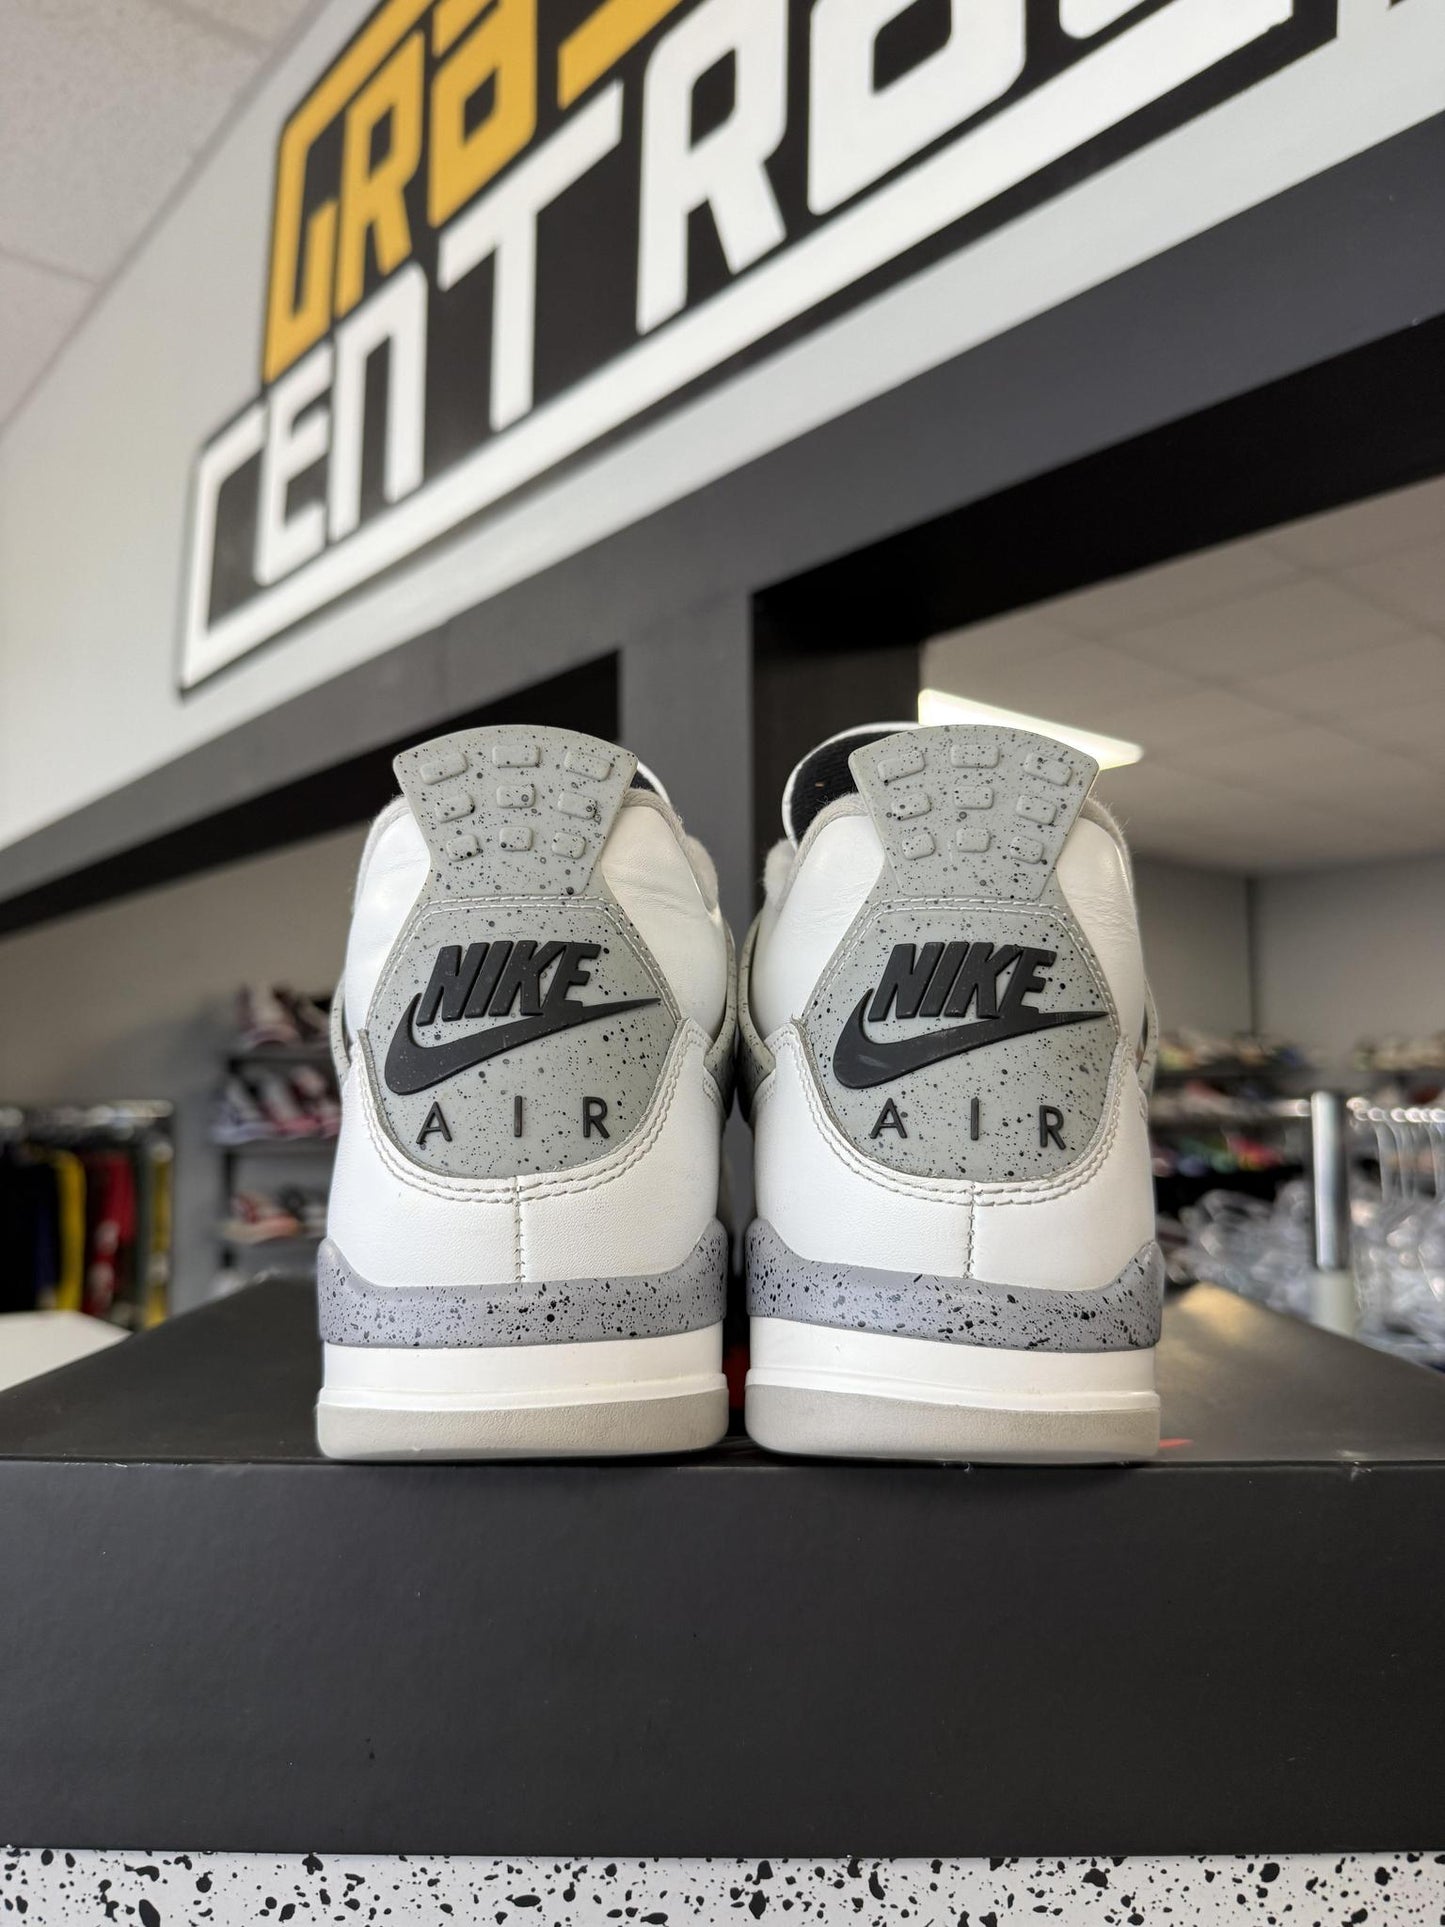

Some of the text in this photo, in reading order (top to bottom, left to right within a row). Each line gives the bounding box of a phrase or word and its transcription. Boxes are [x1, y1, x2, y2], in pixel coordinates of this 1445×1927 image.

[416, 940, 601, 1026] NIKE
[868, 942, 1057, 1022] NIKE
[416, 1095, 610, 1145] AIR
[869, 1097, 1066, 1150] AIR
